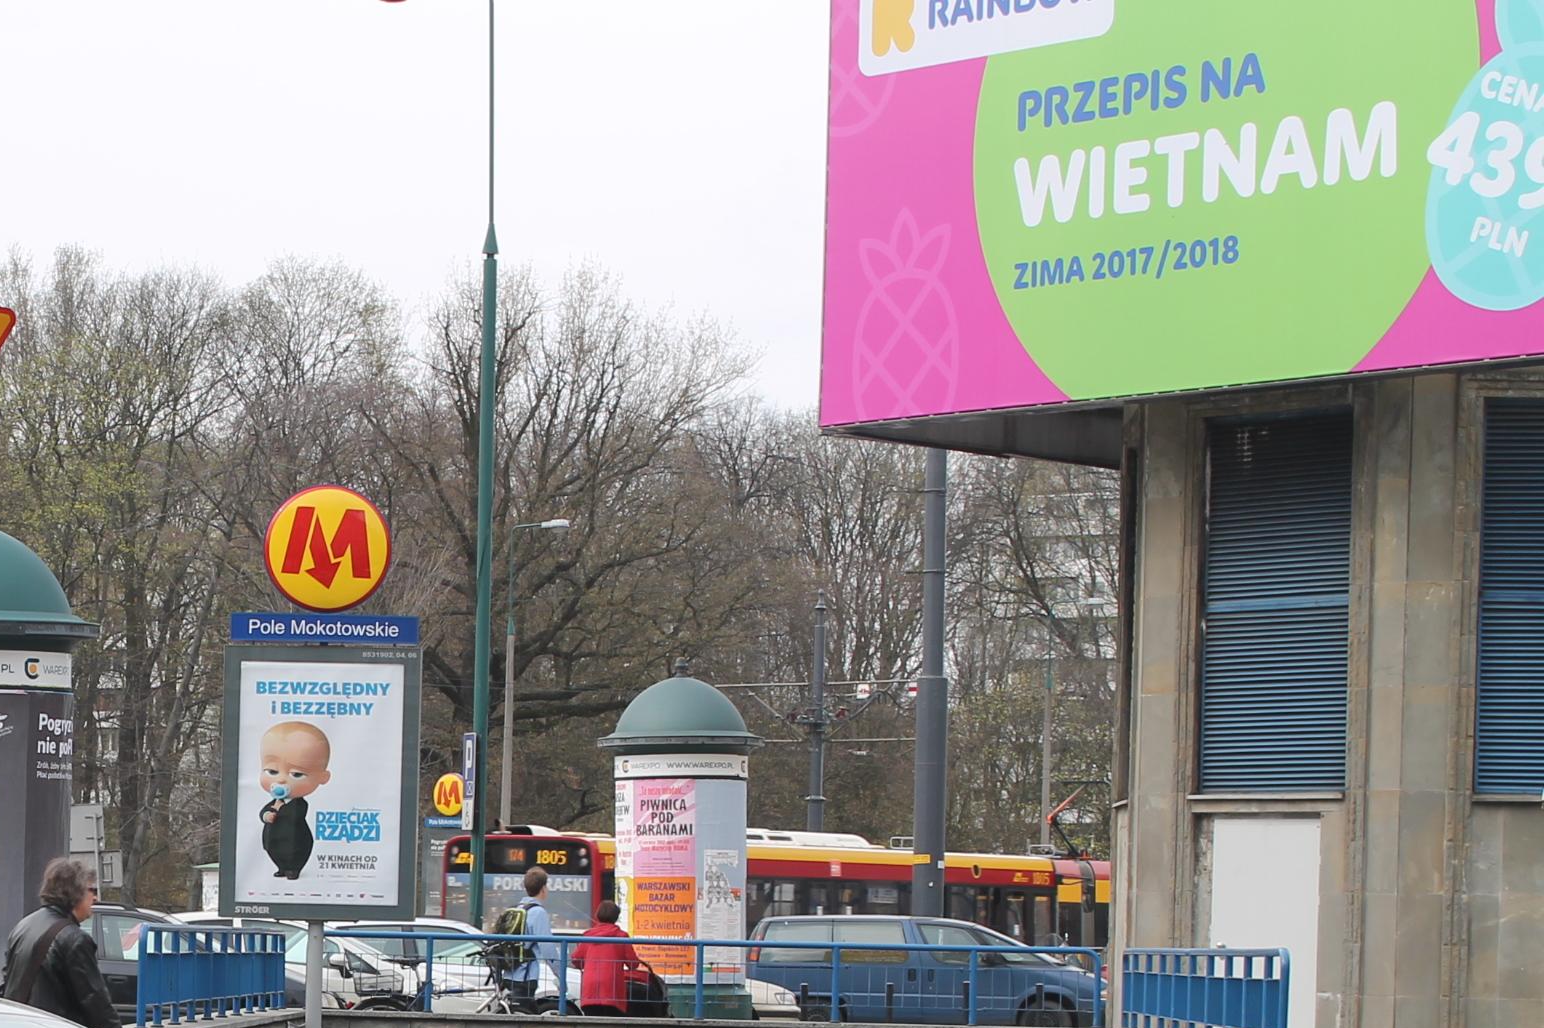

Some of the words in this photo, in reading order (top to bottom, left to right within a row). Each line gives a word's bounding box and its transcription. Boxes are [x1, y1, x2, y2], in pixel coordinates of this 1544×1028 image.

[928, 0, 1092, 29] RAIN
[1017, 65, 1187, 131] PRZEPIS
[1201, 53, 1266, 104] NA
[1013, 101, 1397, 228] WIETNAM
[1470, 216, 1529, 257] PLN
[1013, 255, 1085, 290] ZIMA
[1092, 235, 1240, 279] 2017/2018
[249, 618, 285, 635] Pole
[291, 619, 399, 637] Mokotowskie
[256, 681, 391, 698] BEZWZGLĘDNY
[281, 701, 375, 718] BEZZĘBNY
[37, 737, 56, 754] nie
[640, 799, 687, 811] PIWNICA
[316, 811, 381, 825] DZIECIAK
[651, 811, 674, 823] POD
[315, 825, 380, 843] RZĄDZI
[636, 824, 693, 837] BARANAMI
[328, 855, 363, 863] KINACH
[536, 850, 567, 865] 1805
[637, 882, 690, 891] WARSZAWSKI
[648, 893, 675, 901] BAZAR
[634, 904, 693, 912] MOTOCYKLOWY
